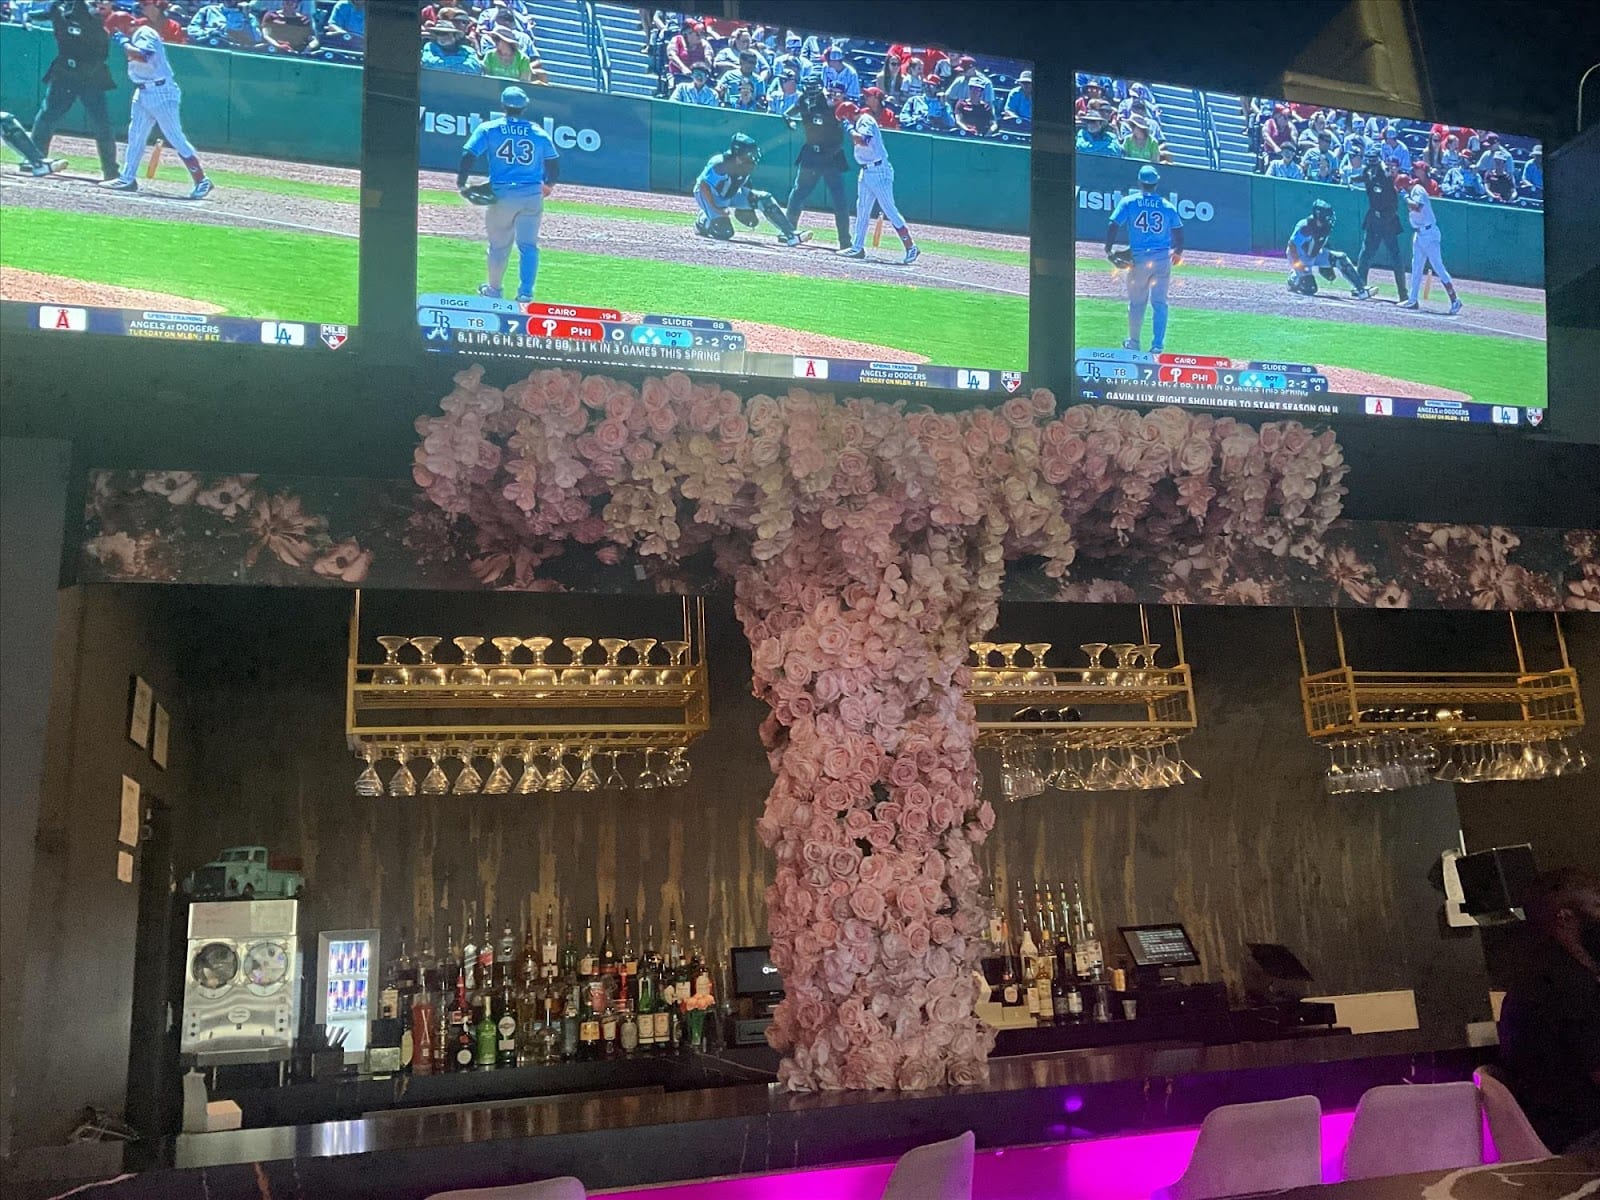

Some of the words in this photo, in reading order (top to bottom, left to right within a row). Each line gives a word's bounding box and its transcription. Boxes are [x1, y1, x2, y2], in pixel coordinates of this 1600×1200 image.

[500, 124, 529, 136] BIGGE
[496, 138, 535, 166] 43
[1134, 210, 1164, 234] 43
[440, 298, 470, 307] BIGGE
[547, 308, 577, 317] CAIRO
[130, 320, 166, 330] ANGELS
[176, 323, 219, 333] DODGERS
[467, 318, 485, 327] TB
[507, 320, 520, 333] 7
[661, 318, 694, 327] SLIDER
[128, 329, 165, 338] TUESDAY
[322, 326, 346, 334] MLB
[570, 326, 592, 337] PHI
[611, 329, 625, 341] 0
[665, 331, 682, 339] BOT
[722, 334, 742, 342] OUTS
[516, 336, 524, 348] 3
[526, 337, 543, 350] ER,
[545, 338, 552, 350] 2
[575, 341, 586, 352] 11
[590, 342, 597, 353] K
[600, 342, 610, 355] IN
[622, 345, 657, 357] GAMES
[660, 347, 682, 360] THIS
[684, 349, 720, 362] SPRING
[728, 343, 737, 351] 0
[1092, 351, 1115, 359] BIGGE
[1174, 357, 1197, 365] CAIRO
[860, 369, 887, 378] ANGELS
[894, 372, 927, 381] DODGERS
[1113, 368, 1126, 376] TB
[1143, 369, 1153, 380] 7
[1191, 373, 1208, 381] PHI
[1223, 374, 1234, 385] 0
[1253, 400, 1280, 410] START
[1282, 402, 1316, 413] SEASON
